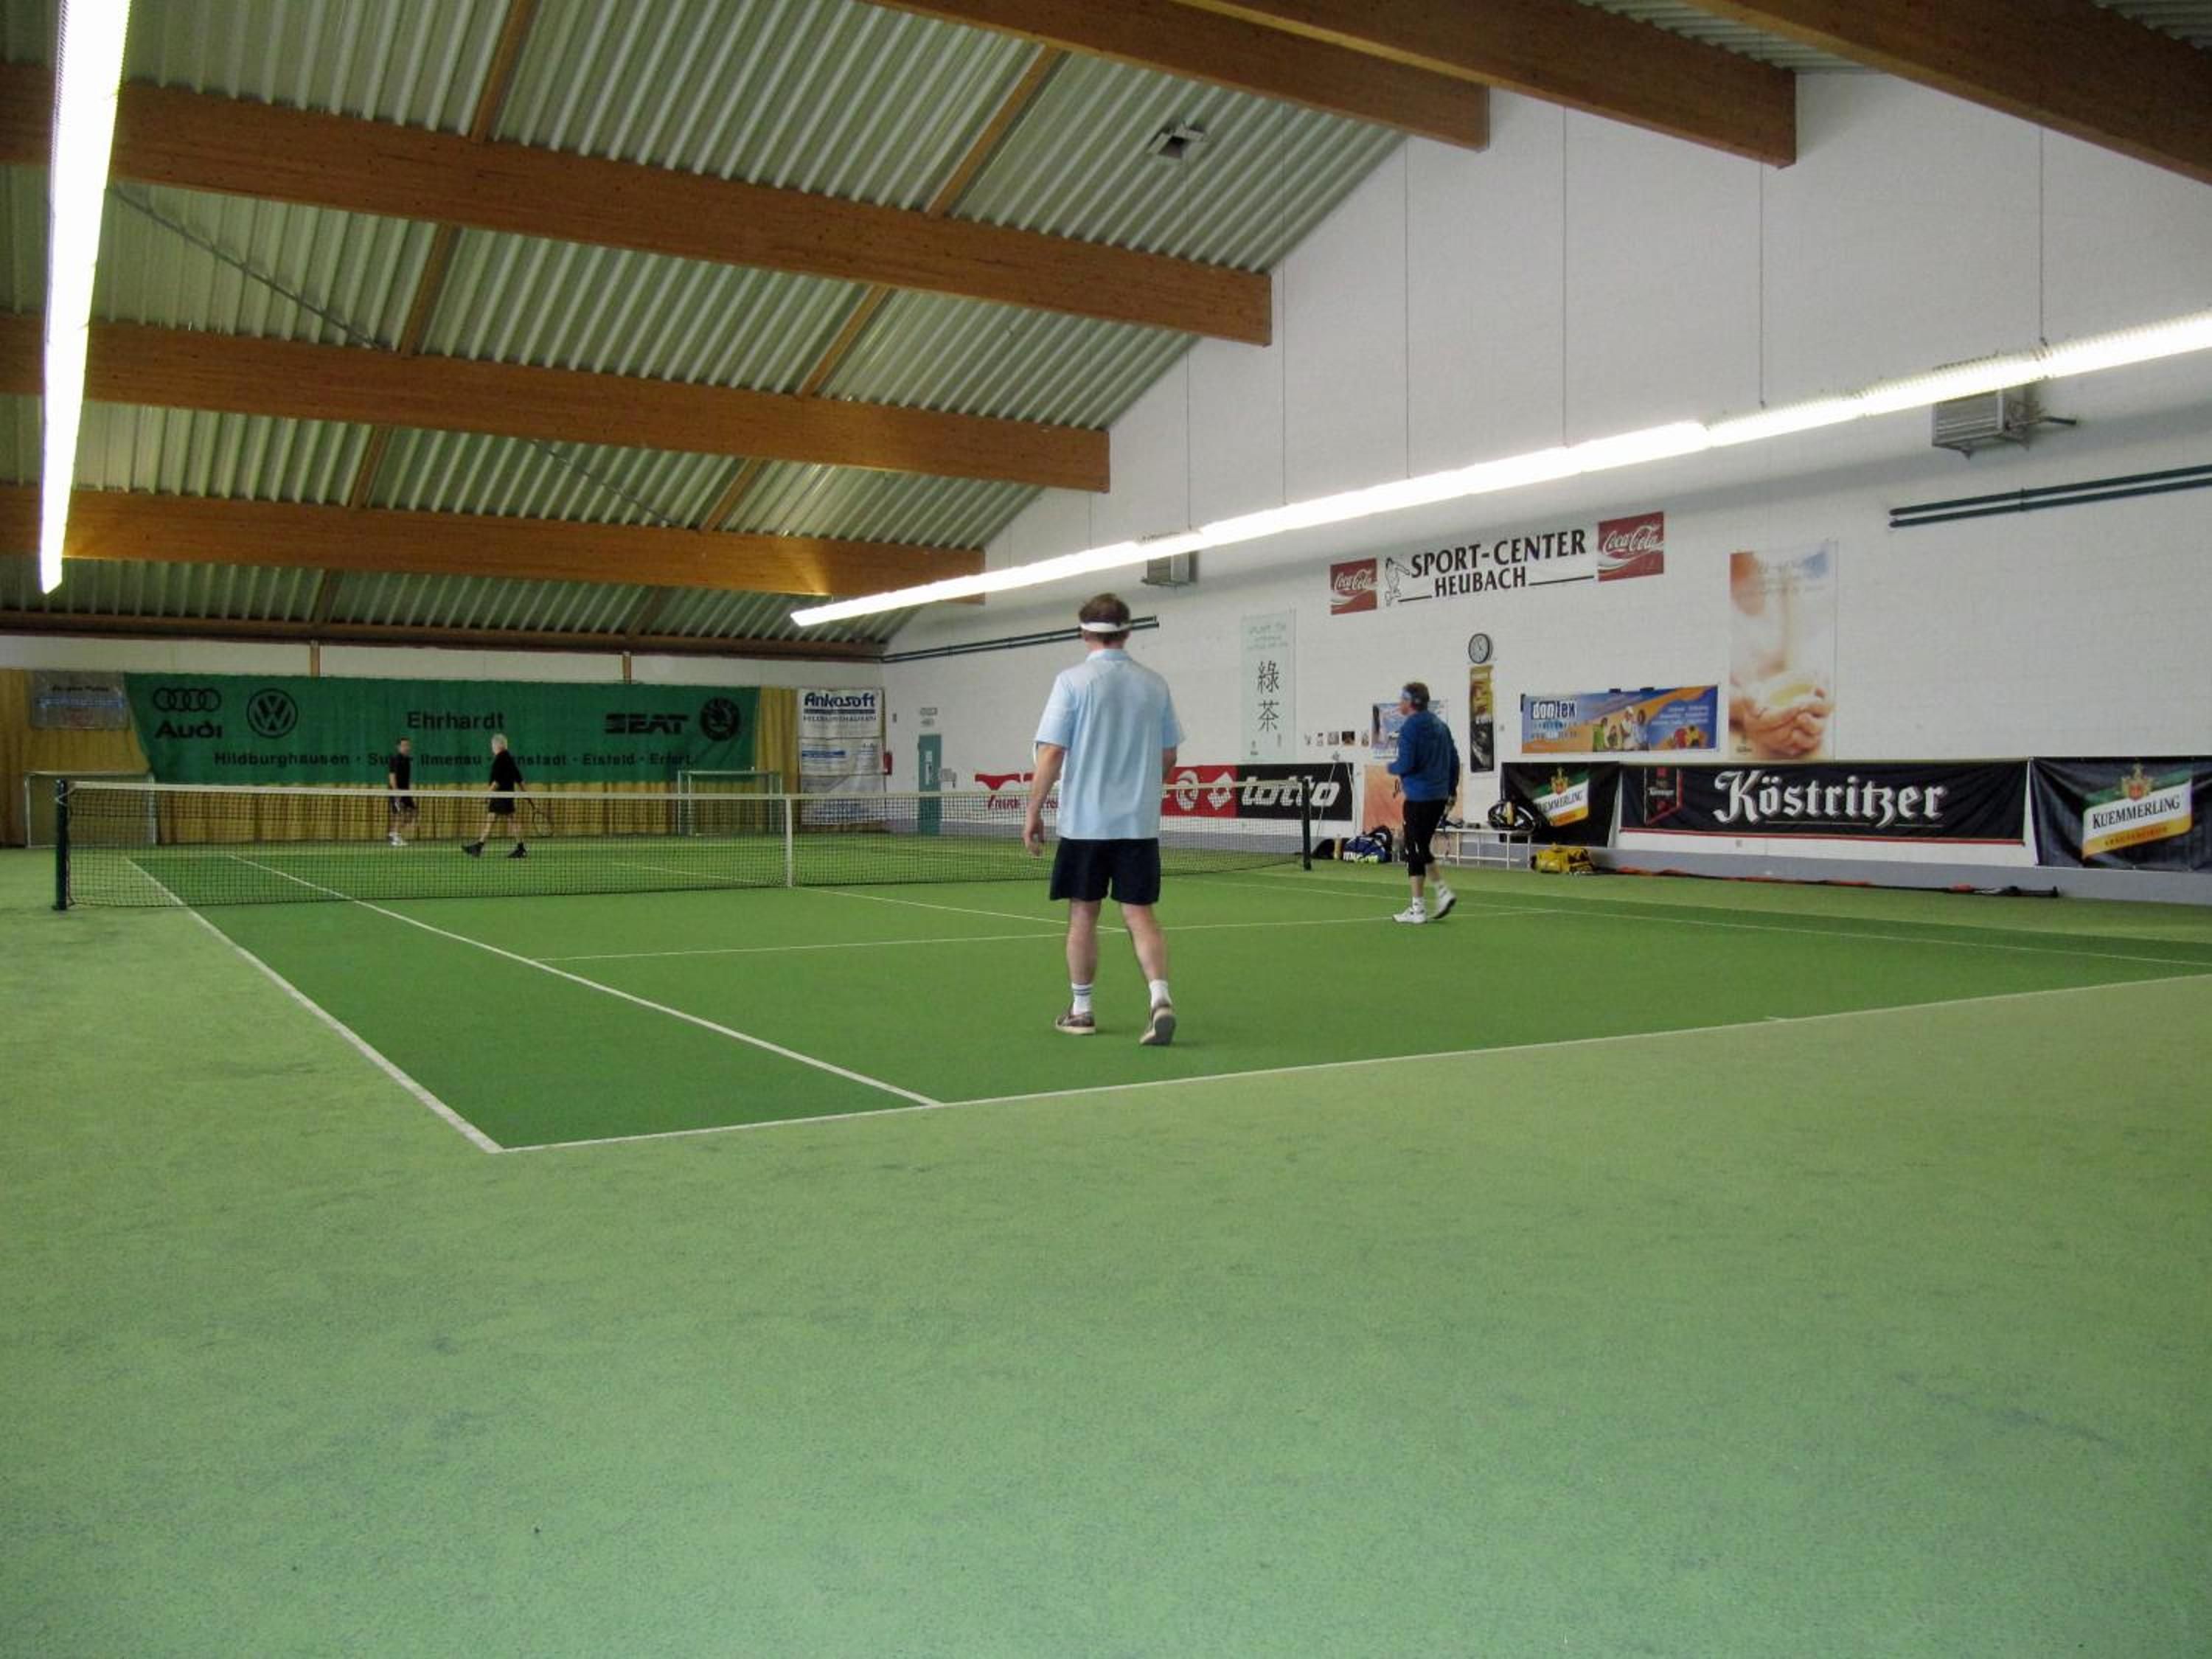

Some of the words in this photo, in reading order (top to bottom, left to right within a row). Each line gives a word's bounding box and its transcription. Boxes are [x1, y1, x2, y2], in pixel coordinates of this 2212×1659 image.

[1411, 529, 1586, 579] SPORT-CENTER
[1434, 566, 1526, 598] HEUBACH
[804, 692, 875, 708] Ankosoft
[154, 720, 223, 739] Audi
[407, 711, 505, 730] Ehrhardt
[605, 712, 689, 734] SEAT
[212, 751, 349, 768] Hildburghausen
[1713, 769, 1947, 827] Köstritzer
[2092, 795, 2181, 830] KUEMMERLING
